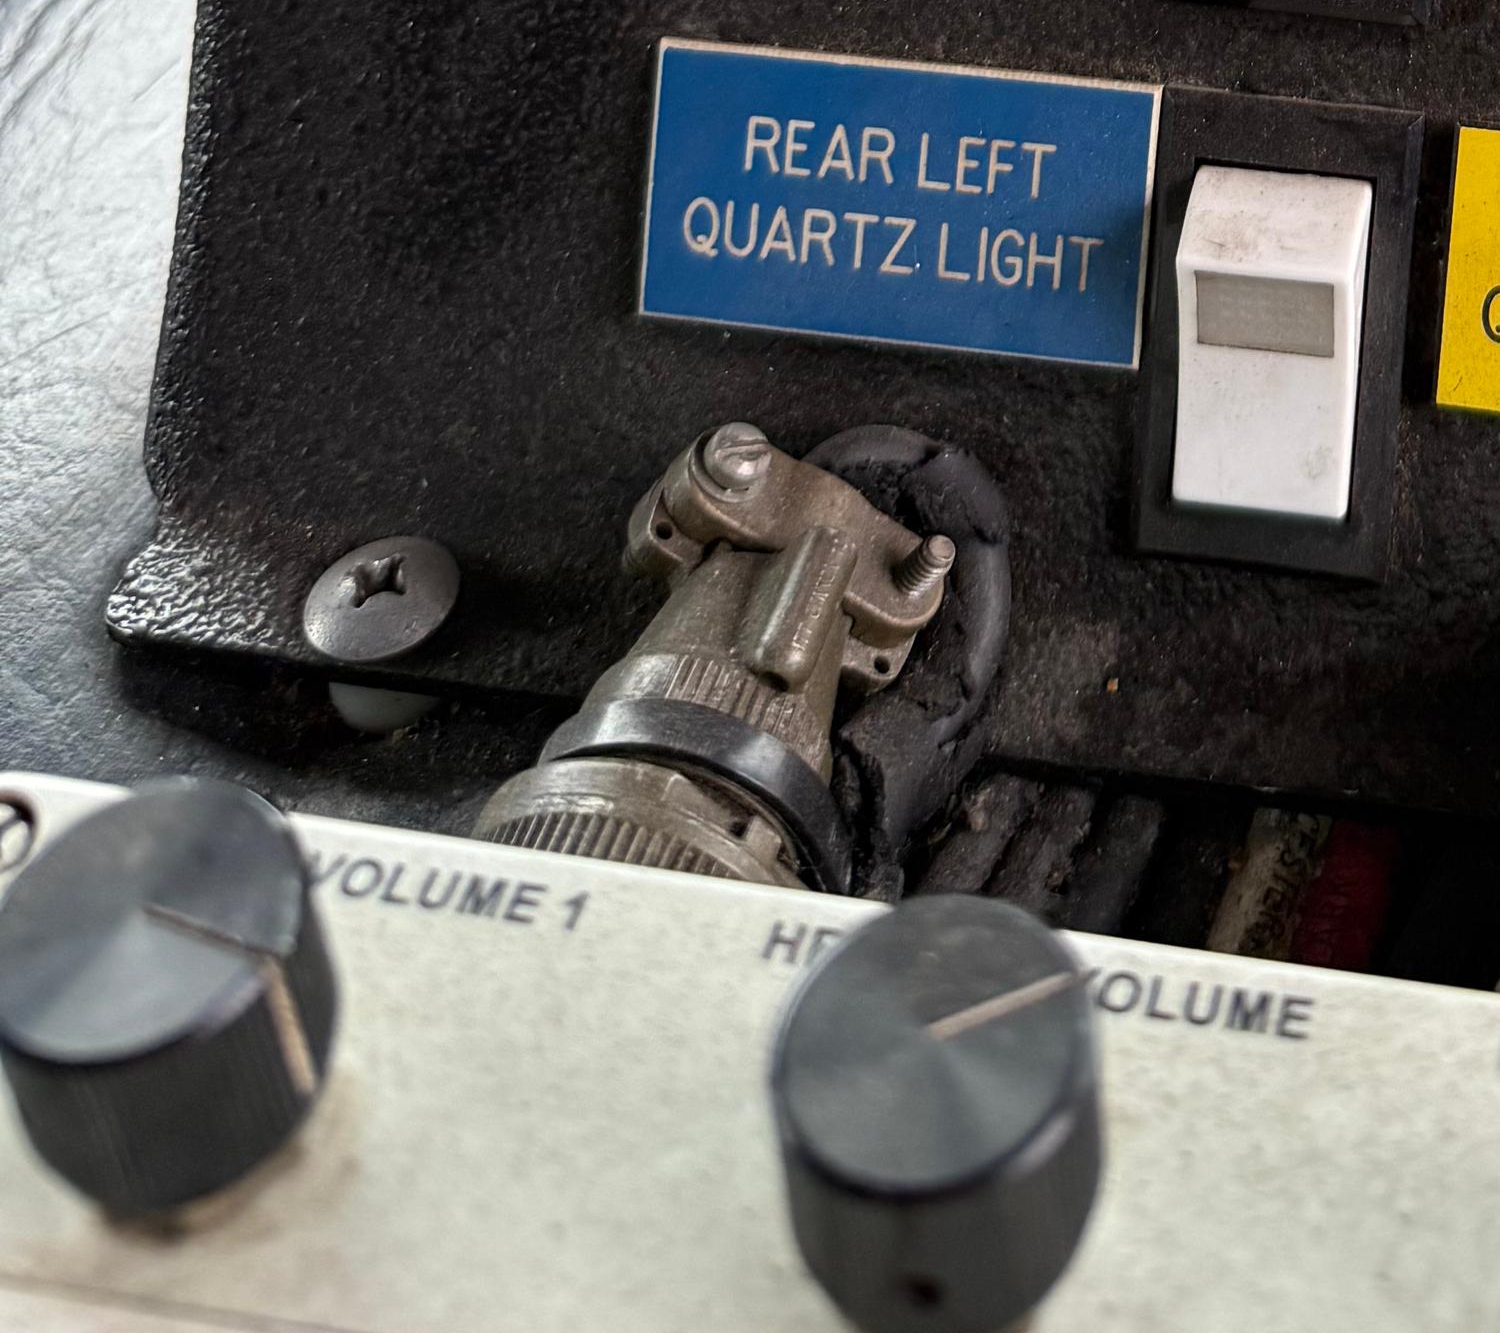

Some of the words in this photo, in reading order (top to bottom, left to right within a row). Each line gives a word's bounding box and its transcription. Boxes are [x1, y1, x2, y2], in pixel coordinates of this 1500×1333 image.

[744, 115, 896, 185] REAR
[917, 133, 1057, 198] LEFT
[683, 197, 917, 275] QUARTZ
[937, 222, 1104, 293] LIGHT
[311, 850, 547, 924] VOLUME
[561, 889, 591, 931] 1
